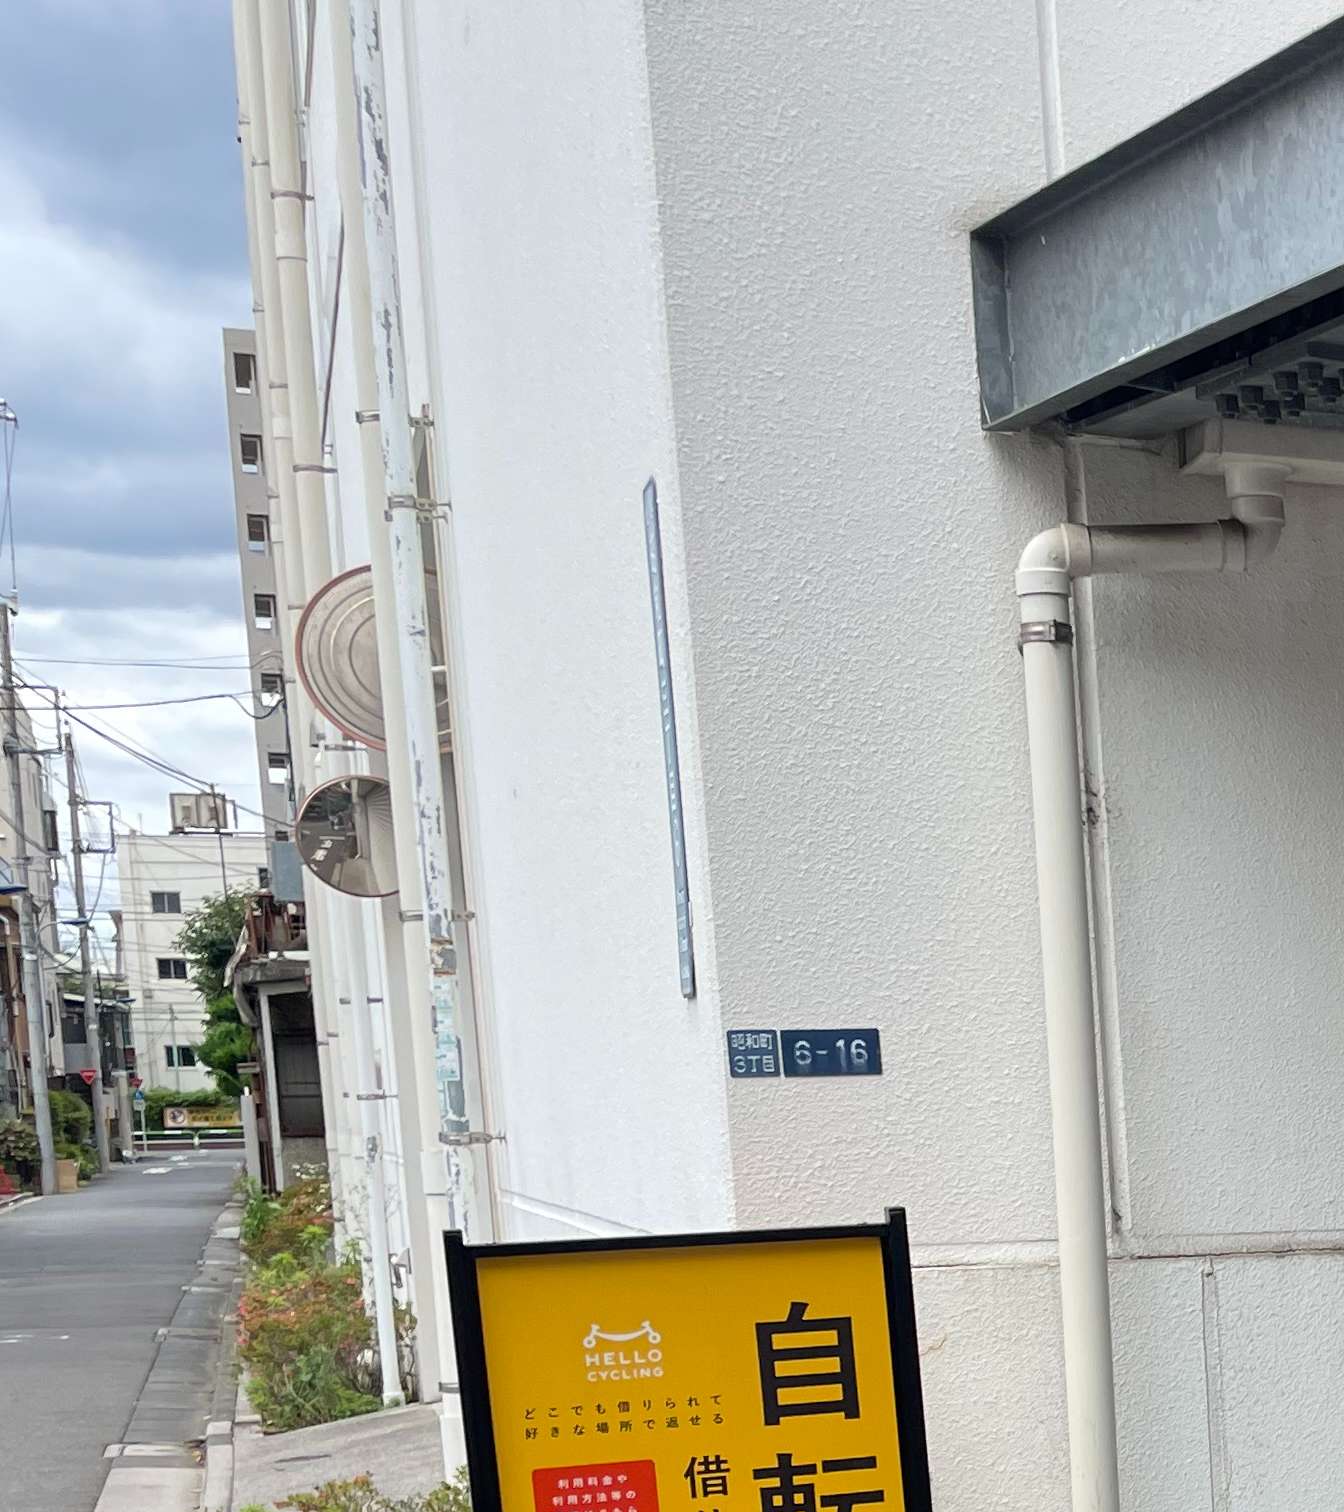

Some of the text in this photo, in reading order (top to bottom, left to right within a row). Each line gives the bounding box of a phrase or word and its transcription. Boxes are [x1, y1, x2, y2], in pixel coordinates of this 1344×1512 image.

[731, 1033, 773, 1050] 昭和町
[793, 1038, 869, 1067] 6-16
[733, 1055, 775, 1073] 3丁目
[585, 1349, 662, 1367] HELLO
[587, 1366, 664, 1382] CYCLING
[524, 1394, 722, 1420] どこでも借りられて
[524, 1413, 724, 1440] 好きな場所で返せる
[558, 1474, 628, 1490] 利用料金や
